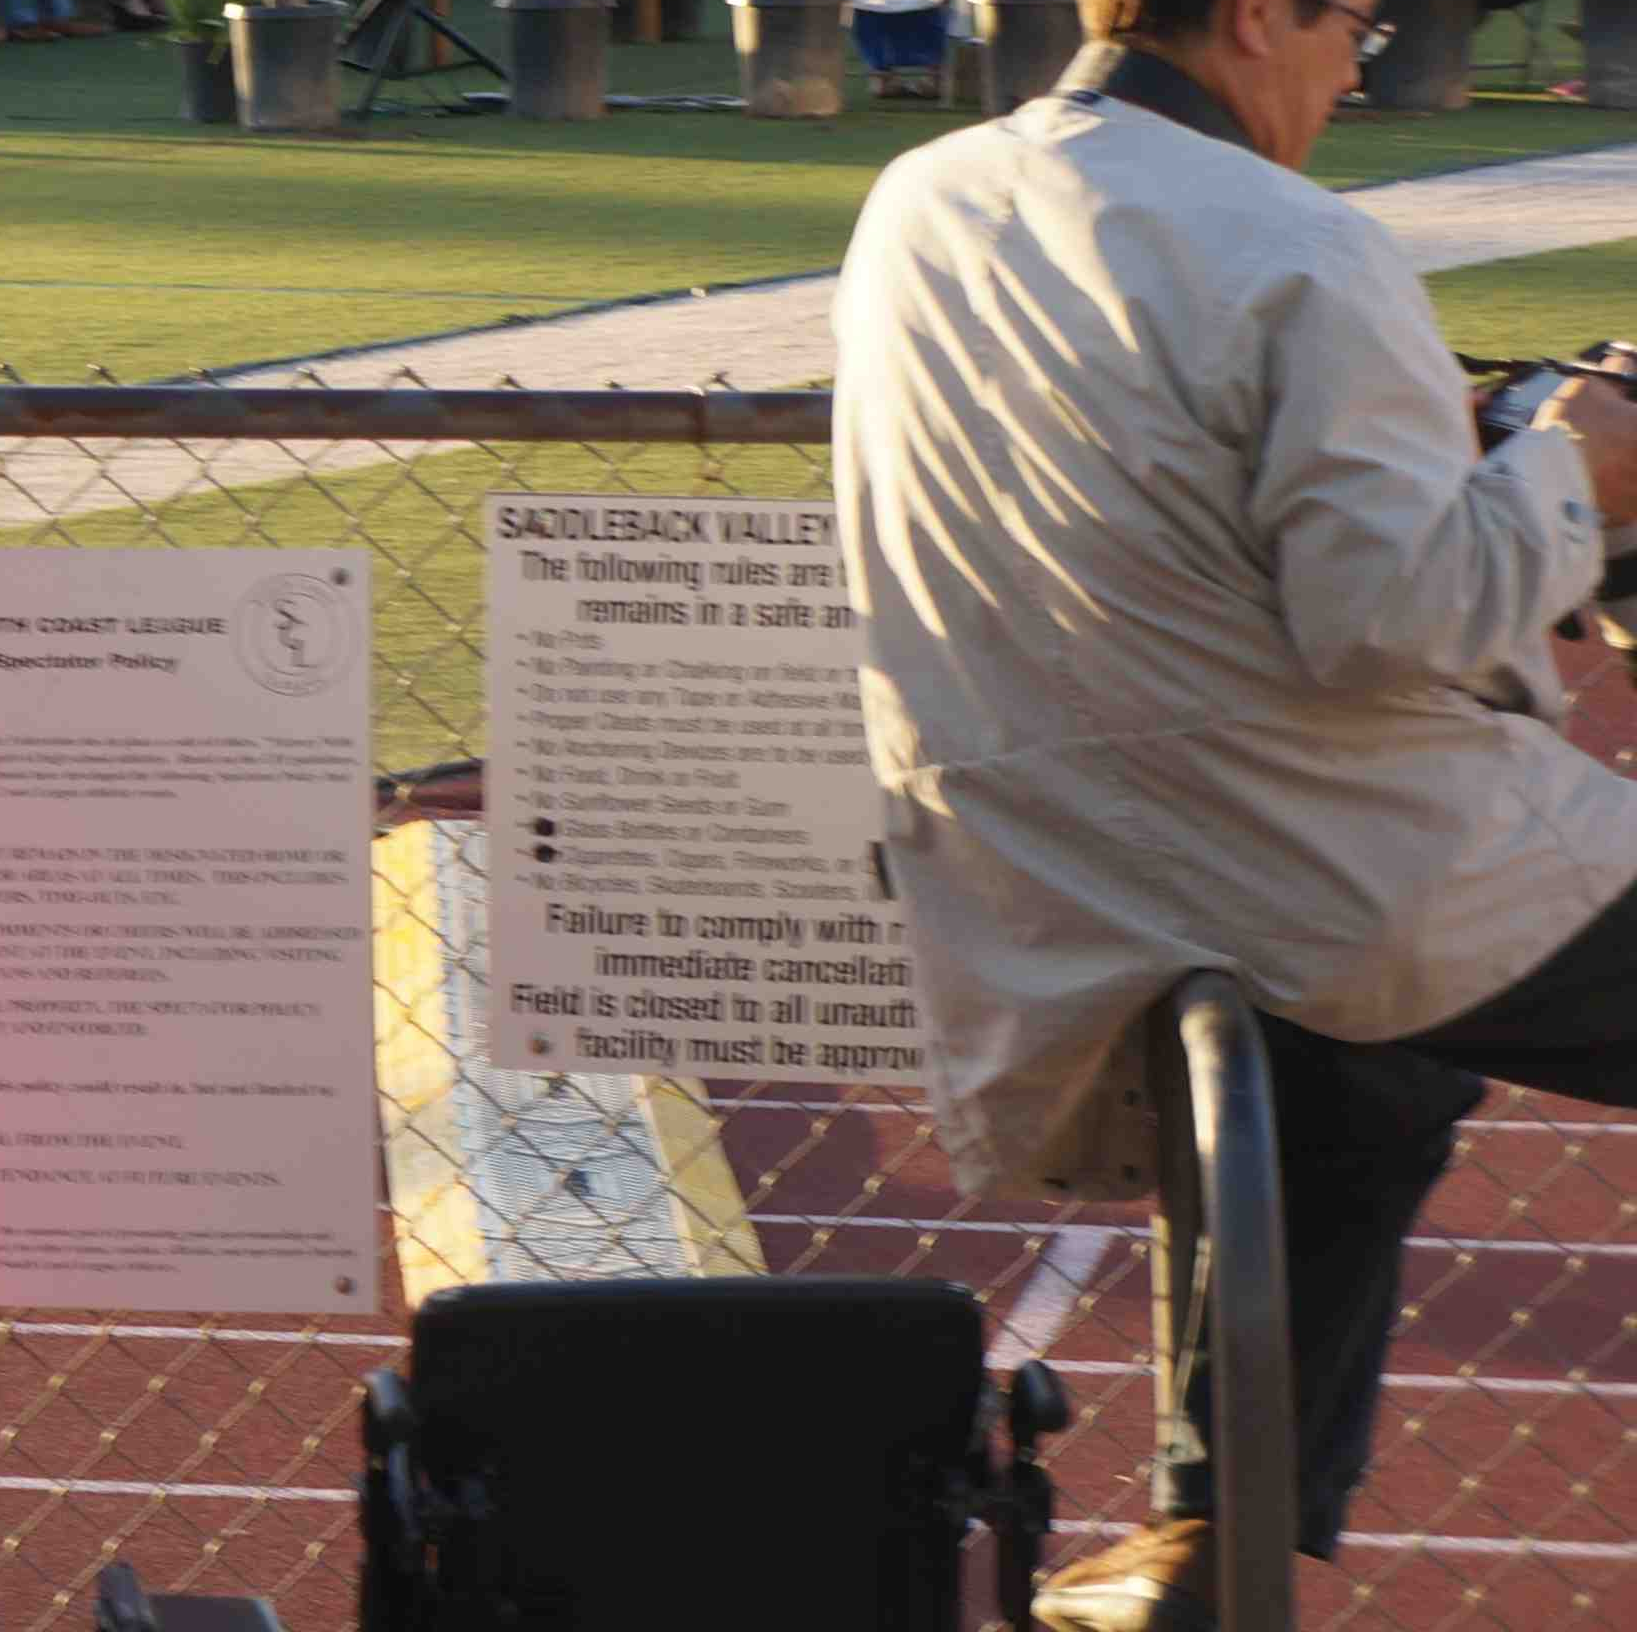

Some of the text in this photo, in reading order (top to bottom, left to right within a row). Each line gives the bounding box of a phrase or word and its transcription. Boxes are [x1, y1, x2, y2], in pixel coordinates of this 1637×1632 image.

[496, 507, 835, 546] SADDLEBACK VALLEY
[517, 550, 572, 582] The
[573, 551, 706, 591] following
[708, 556, 781, 586] rules
[787, 562, 833, 588] are
[35, 616, 121, 635] COAST
[125, 617, 227, 636] LEAGUE
[576, 594, 693, 625] remains
[694, 595, 725, 626] in
[727, 603, 749, 627] a
[754, 596, 818, 629] safe
[107, 651, 180, 676] Policy
[544, 901, 881, 949] Failure to comply with
[594, 946, 756, 982] immediate
[509, 982, 584, 1016] Field
[587, 985, 617, 1017] is
[622, 987, 725, 1022] closed
[730, 991, 763, 1024] to
[768, 993, 810, 1024] all
[573, 1026, 677, 1067] facility
[684, 1033, 765, 1065] must
[769, 1033, 809, 1066] be
